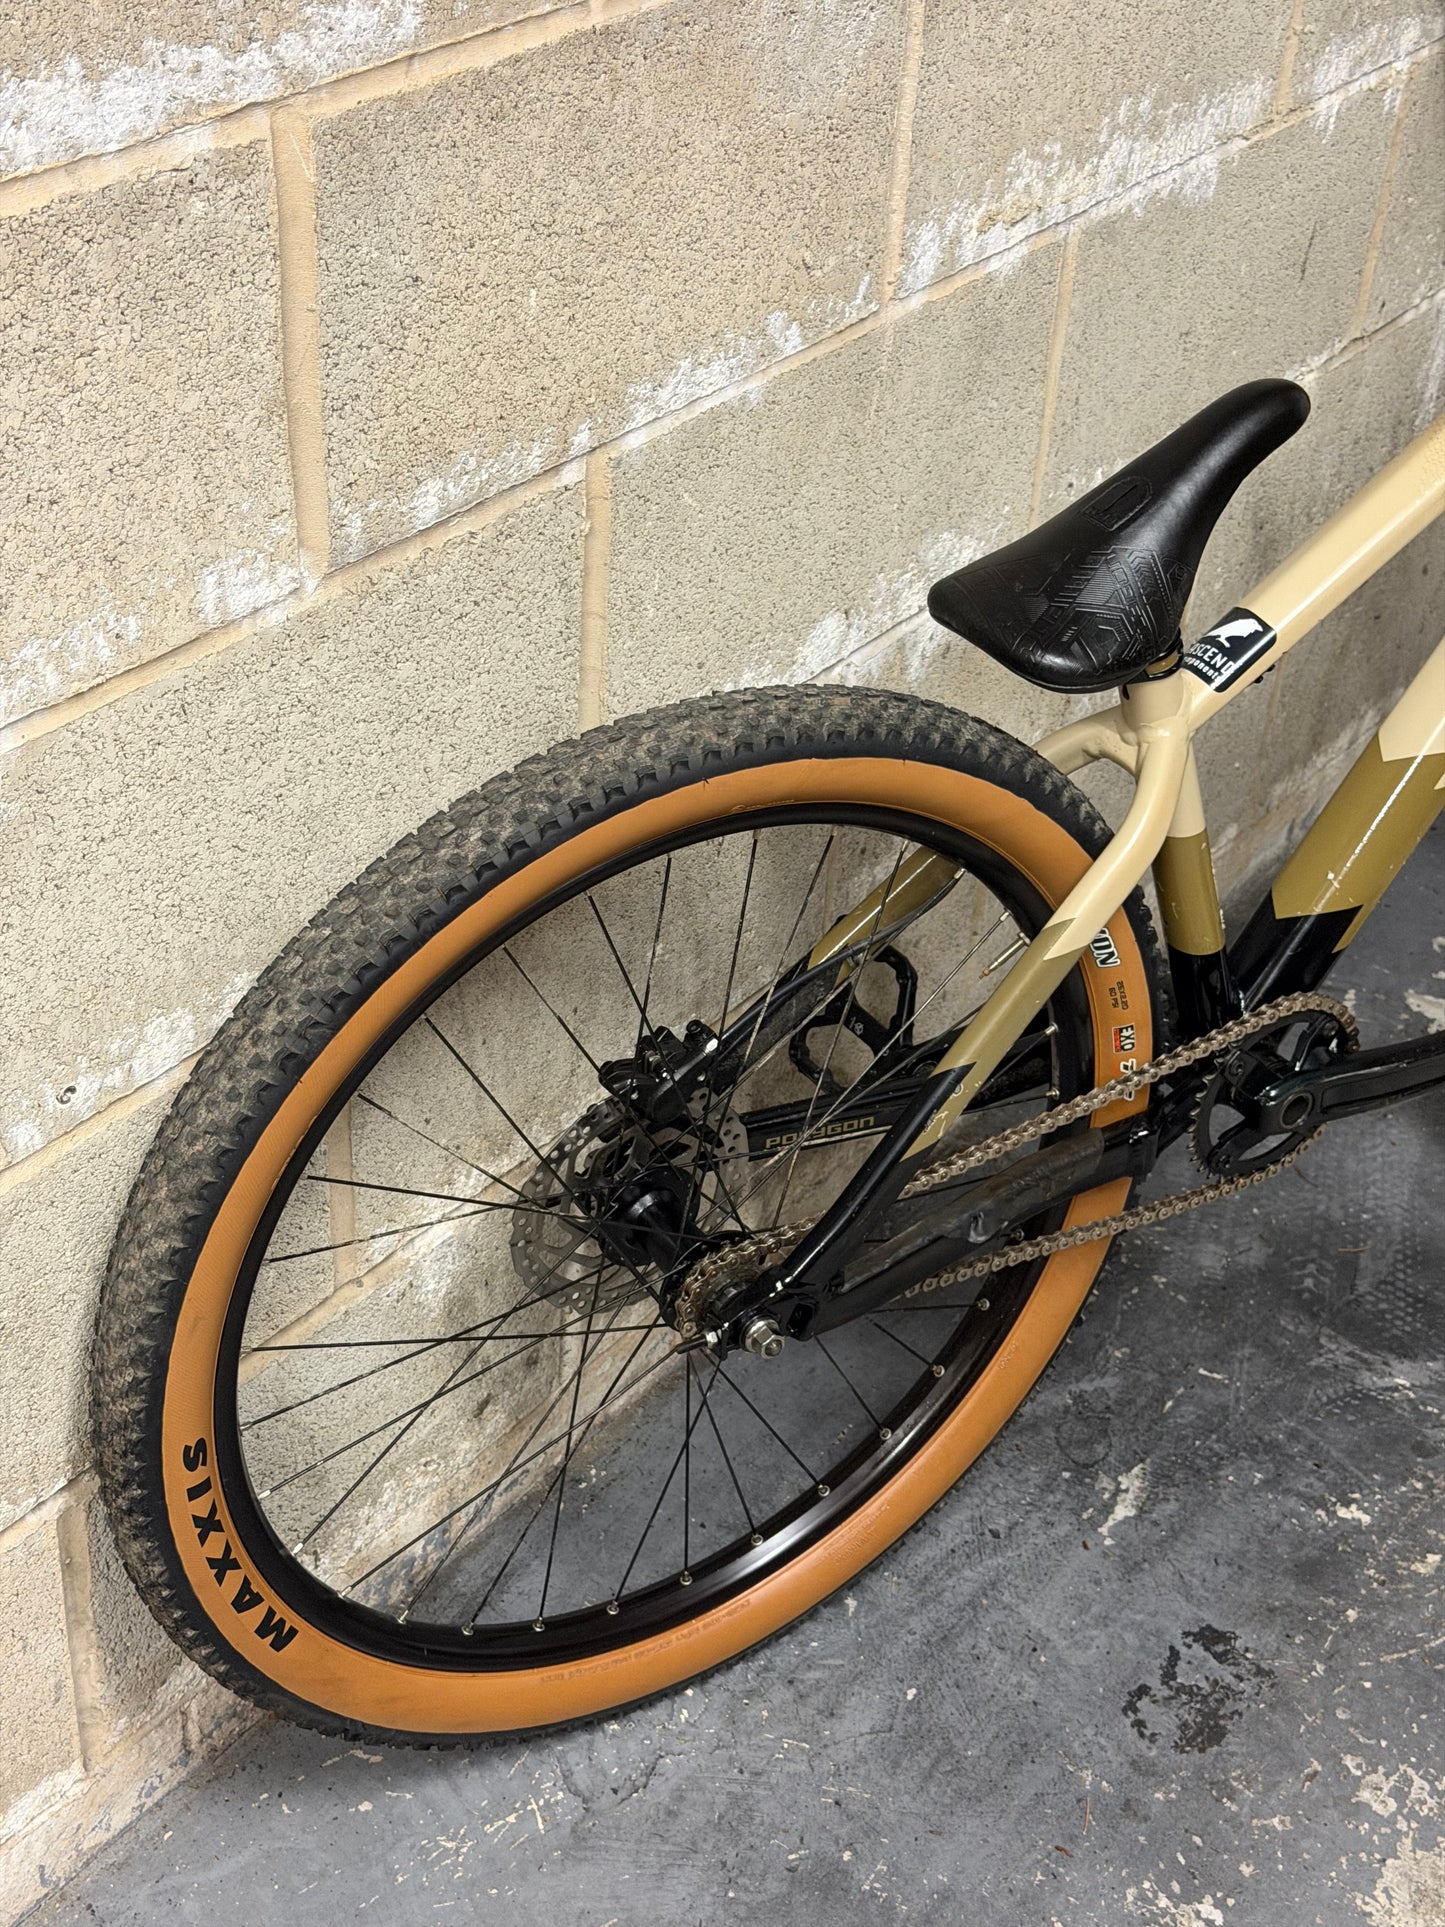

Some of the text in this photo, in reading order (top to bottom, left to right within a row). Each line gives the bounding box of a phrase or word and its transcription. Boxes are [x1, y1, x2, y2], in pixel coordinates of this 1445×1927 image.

[1119, 1025, 1135, 1053] EXO
[764, 1116, 875, 1149] POYGON
[182, 1437, 299, 1653] MAXXIS
